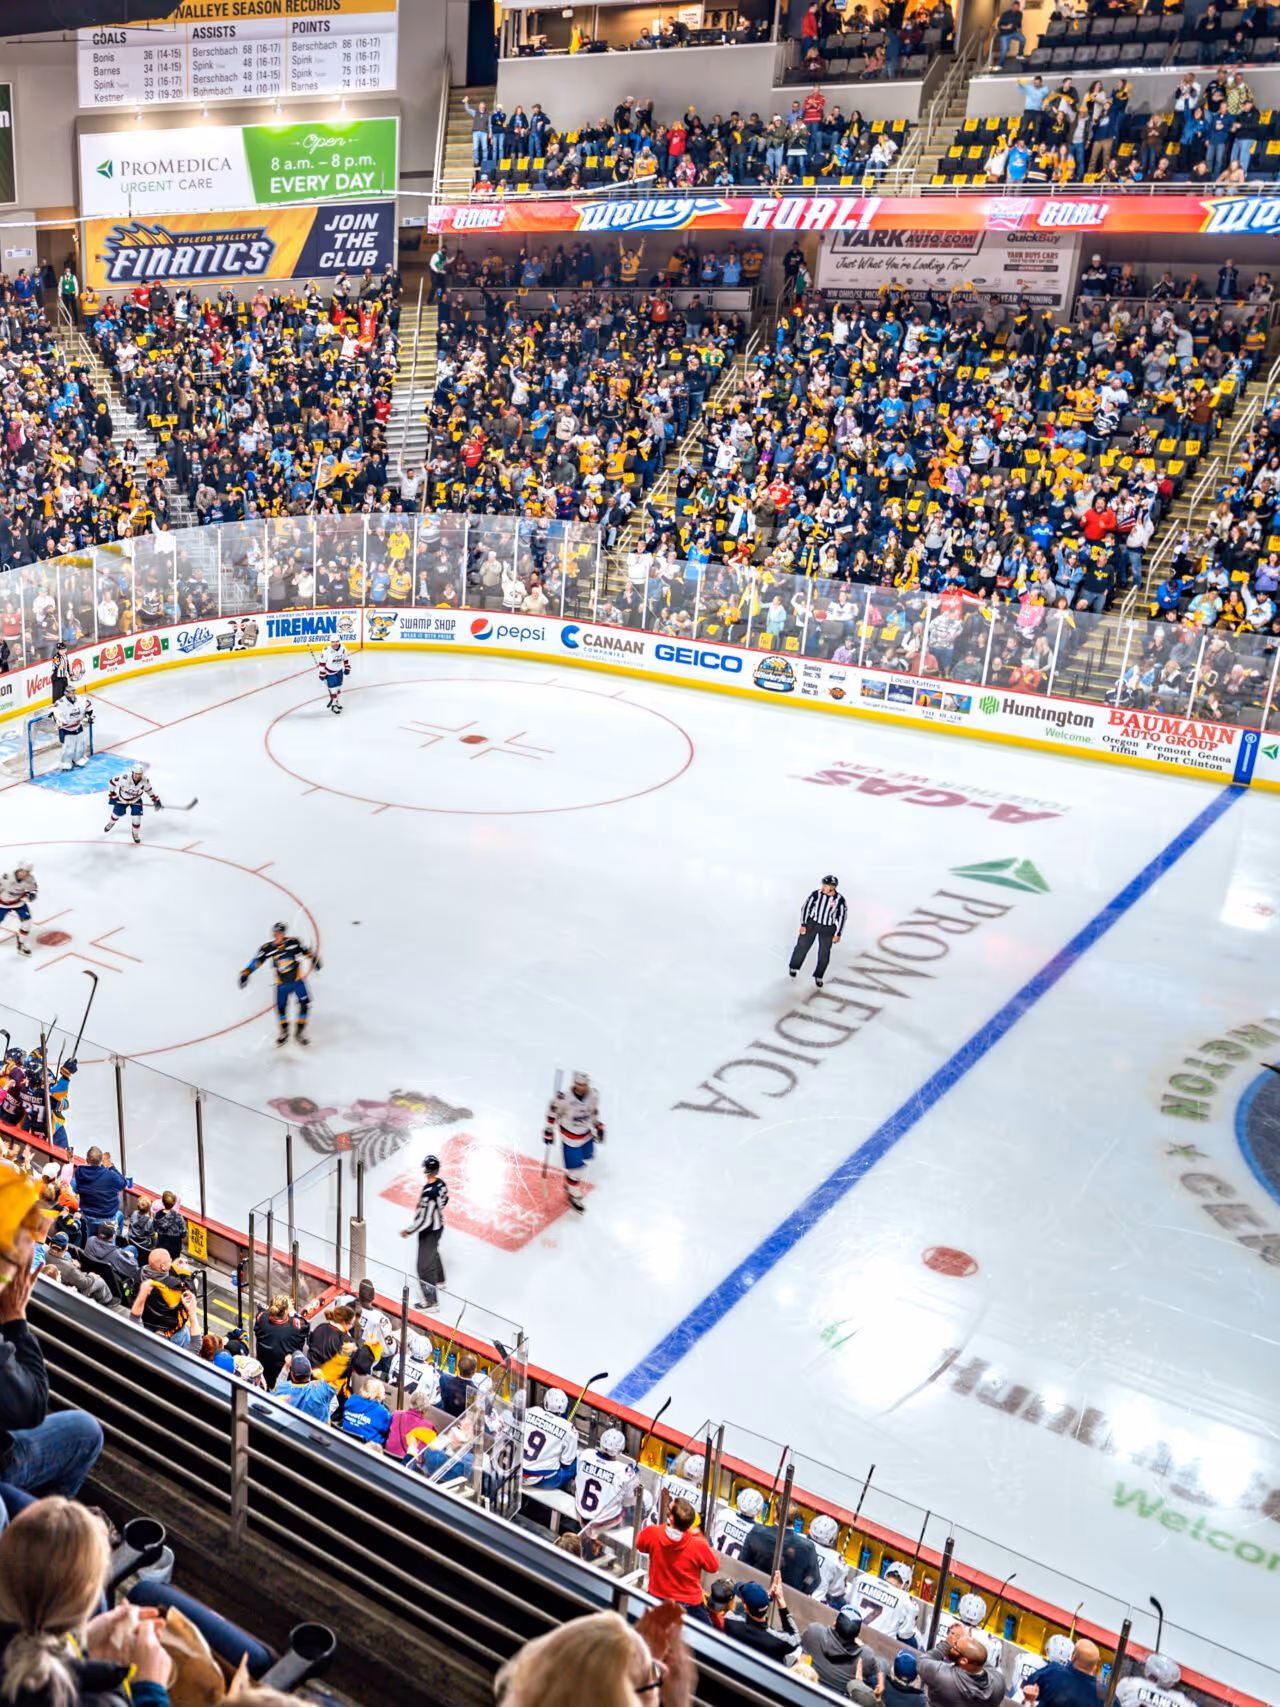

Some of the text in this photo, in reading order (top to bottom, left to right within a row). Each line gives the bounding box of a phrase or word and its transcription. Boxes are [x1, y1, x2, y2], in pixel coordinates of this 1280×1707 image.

[175, 0, 341, 19] WALLEYE SEASON RECORDS
[192, 25, 236, 39] ASSISTS
[292, 20, 331, 33] POINTS
[93, 32, 127, 45] GOALS
[292, 37, 381, 51] Berschbach 86 (16-17)
[93, 49, 182, 63] Bonis 36 (14-15)
[192, 46, 238, 57] Berschbach
[256, 43, 281, 54] (16-17)
[292, 51, 381, 66] Spink 76 (16-17)
[93, 62, 182, 76] Barnes 34 (14-15)
[192, 56, 281, 72] Spink 48 (16-17)
[291, 68, 313, 79] Spink
[342, 66, 352, 76] 75
[94, 80, 115, 91] Spink
[144, 77, 154, 87] 33
[157, 75, 182, 87] (16-17)
[192, 69, 281, 84] Berschbach 48 (14-15)
[291, 82, 319, 92] Barnes
[342, 79, 351, 88] 74
[94, 93, 124, 102] Kestner
[144, 91, 154, 100] 33
[193, 86, 234, 97] Bohmbach
[243, 84, 253, 93] 44
[302, 134, 347, 155] Open
[270, 154, 376, 171] 8 a.m. 8 p.m.
[120, 178, 213, 193] URGENT CARE
[270, 172, 375, 193] EVERY DAY
[324, 213, 379, 232] JOIN
[452, 209, 506, 229] GOAL!
[742, 197, 881, 230] GOAL!
[1035, 200, 1109, 228] GOAL!
[177, 231, 258, 243] TOLEDO WALLEYE
[333, 231, 378, 250] THE
[841, 230, 975, 248] YARK AUTO.COM
[1006, 232, 1061, 244] QuickBuy
[111, 241, 270, 279] FINATICS
[319, 249, 378, 268] CLUB
[1007, 251, 1024, 259] YARK
[1042, 252, 1059, 260] CARS
[835, 256, 971, 274] Just What You're Looking For!
[827, 289, 839, 298] NW
[266, 615, 337, 638] TIREMAN
[400, 618, 456, 631] SWAMP SHOP
[496, 623, 547, 642] pepsi
[293, 634, 331, 644] AUTO SERVICE
[583, 633, 643, 655] CANAAN
[583, 647, 625, 658] COMPANIES
[654, 643, 743, 673] GEICO
[891, 675, 941, 690] Local Matters
[1002, 697, 1095, 729] Huntington
[1044, 727, 1094, 746] Welcome.
[1107, 710, 1237, 745] BAUMANN
[1119, 727, 1220, 751] AUTO GROUP
[1102, 735, 1139, 749] Oregon
[1146, 742, 1192, 757] Fremont
[1197, 751, 1232, 764] Genoa
[1109, 745, 1223, 771] Tiffin Port Clinton
[800, 769, 1065, 824] A-GAS
[670, 888, 1015, 1122] PROMEDICA
[526, 1412, 565, 1439] SACCOMAN
[523, 1430, 547, 1462] 9
[581, 1478, 602, 1513] 6
[858, 1581, 899, 1609] LAMBDIN
[857, 1600, 883, 1628] 7
